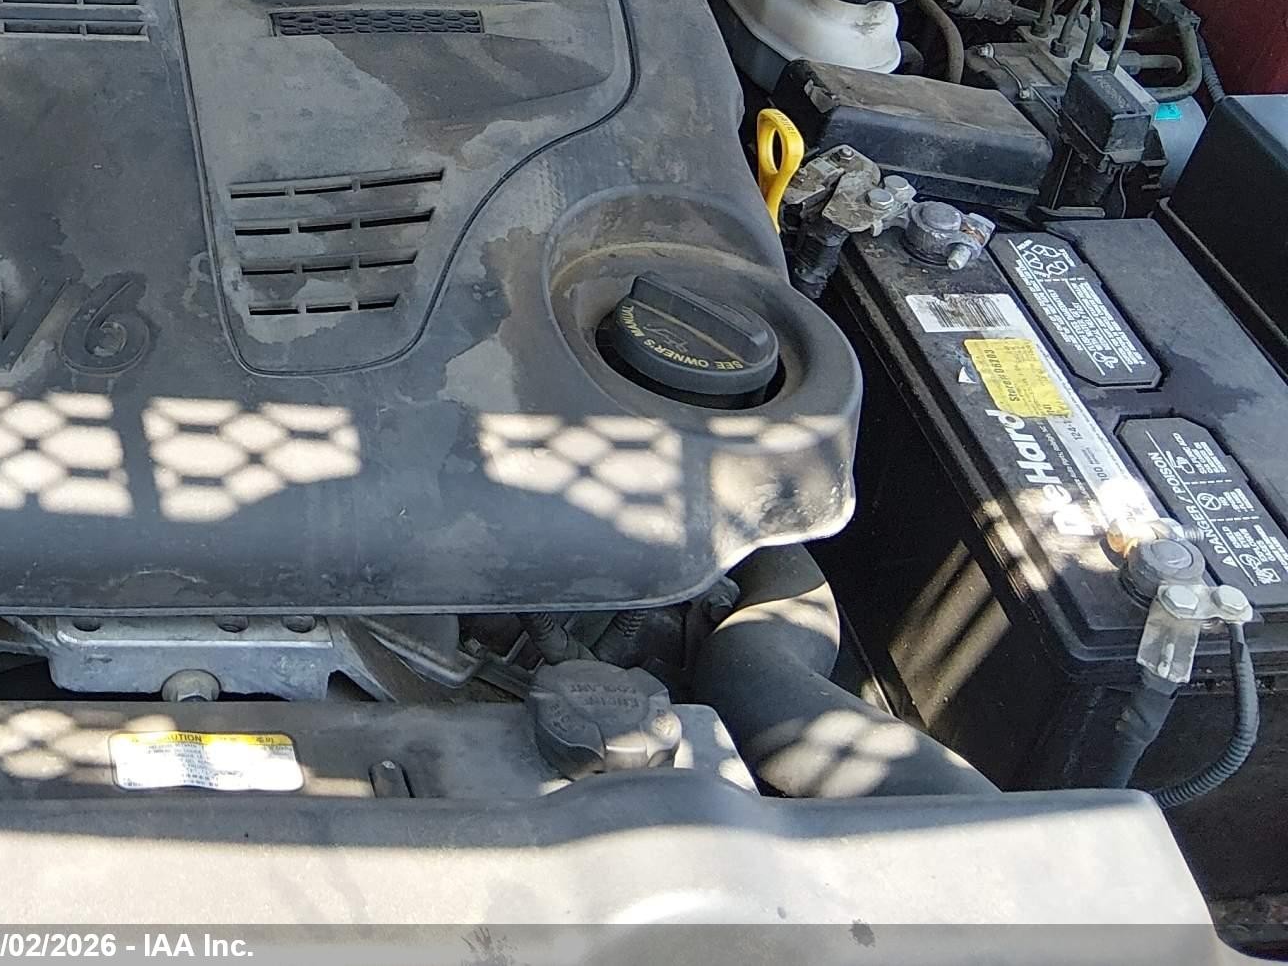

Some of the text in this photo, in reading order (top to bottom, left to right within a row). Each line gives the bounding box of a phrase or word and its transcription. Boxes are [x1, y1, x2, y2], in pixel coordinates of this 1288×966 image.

[643, 338, 709, 368] OWNER'S
[714, 359, 744, 369] SEE
[1148, 451, 1186, 496] POISON
[1186, 505, 1228, 554] DANGER
[161, 733, 203, 743] UTION
